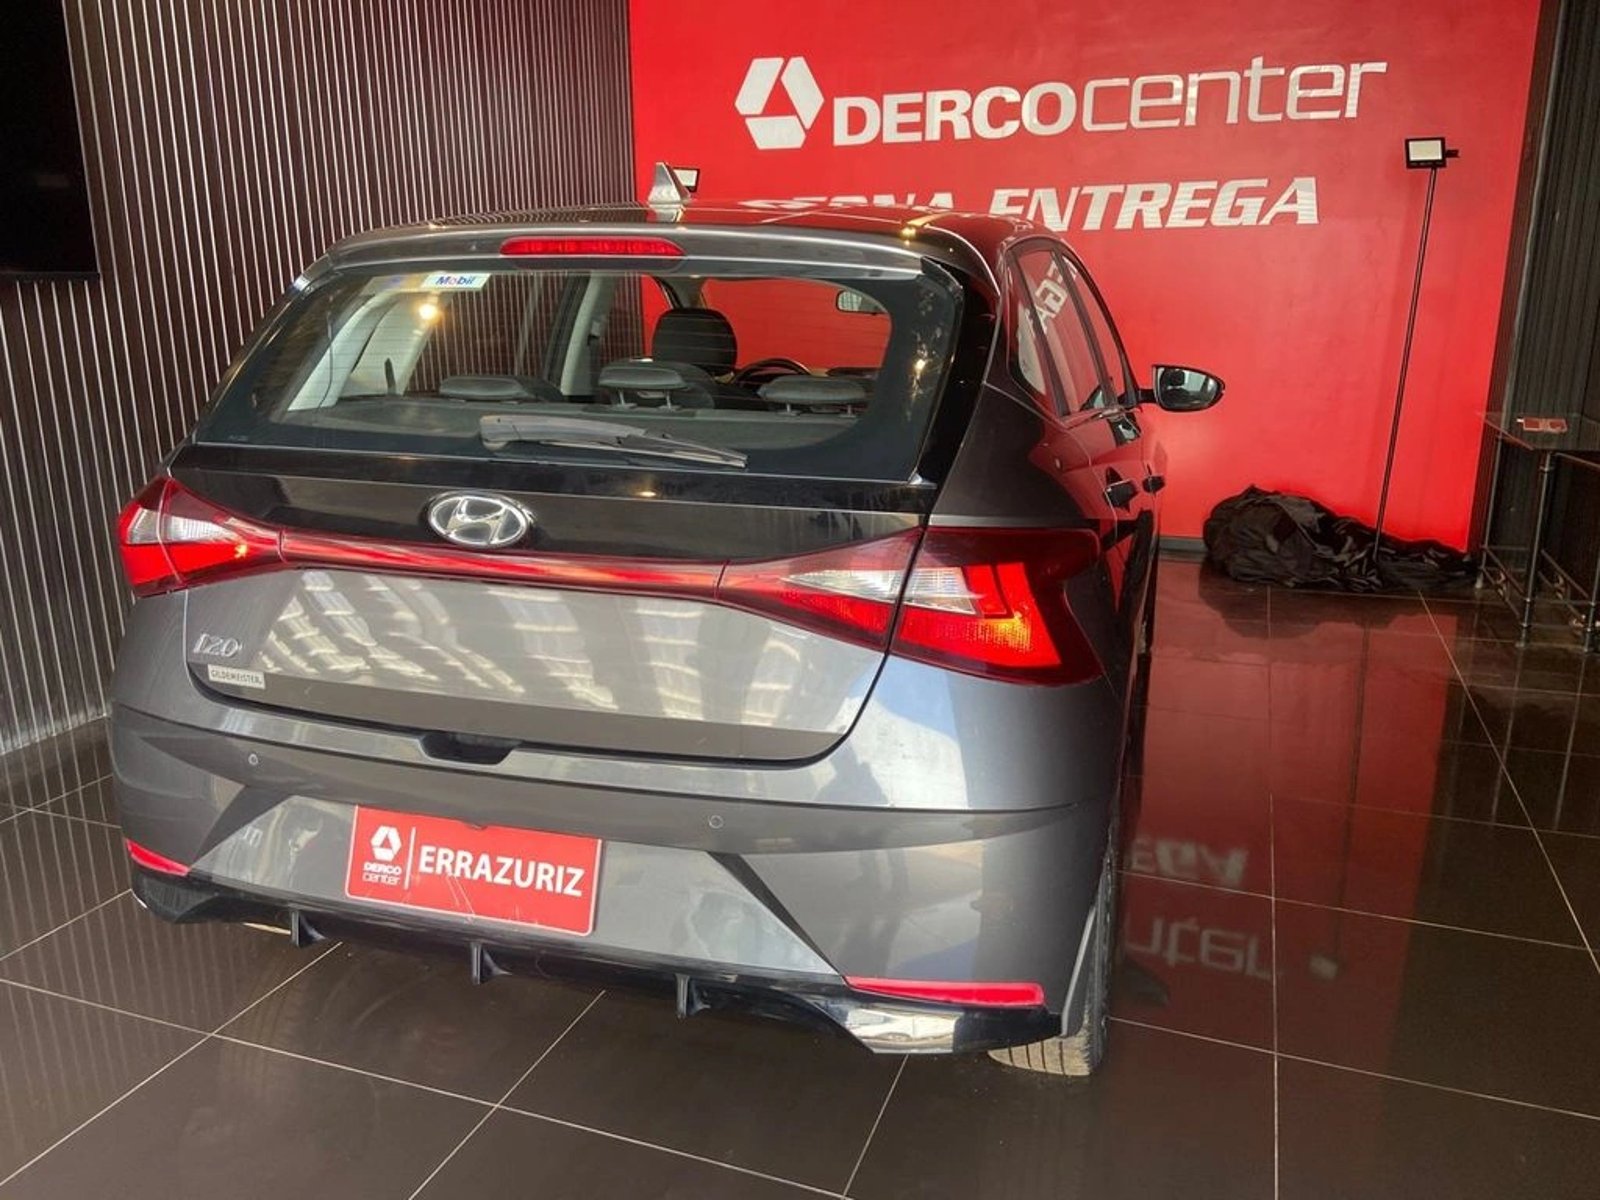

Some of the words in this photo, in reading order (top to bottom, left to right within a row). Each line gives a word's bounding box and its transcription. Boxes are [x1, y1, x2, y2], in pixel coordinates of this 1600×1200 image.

[988, 177, 1319, 232] ENTREGA
[435, 276, 476, 286] Mobil
[363, 861, 402, 876] DERCO
[418, 845, 586, 897] ERRAZURIZ
[362, 872, 401, 887] center
